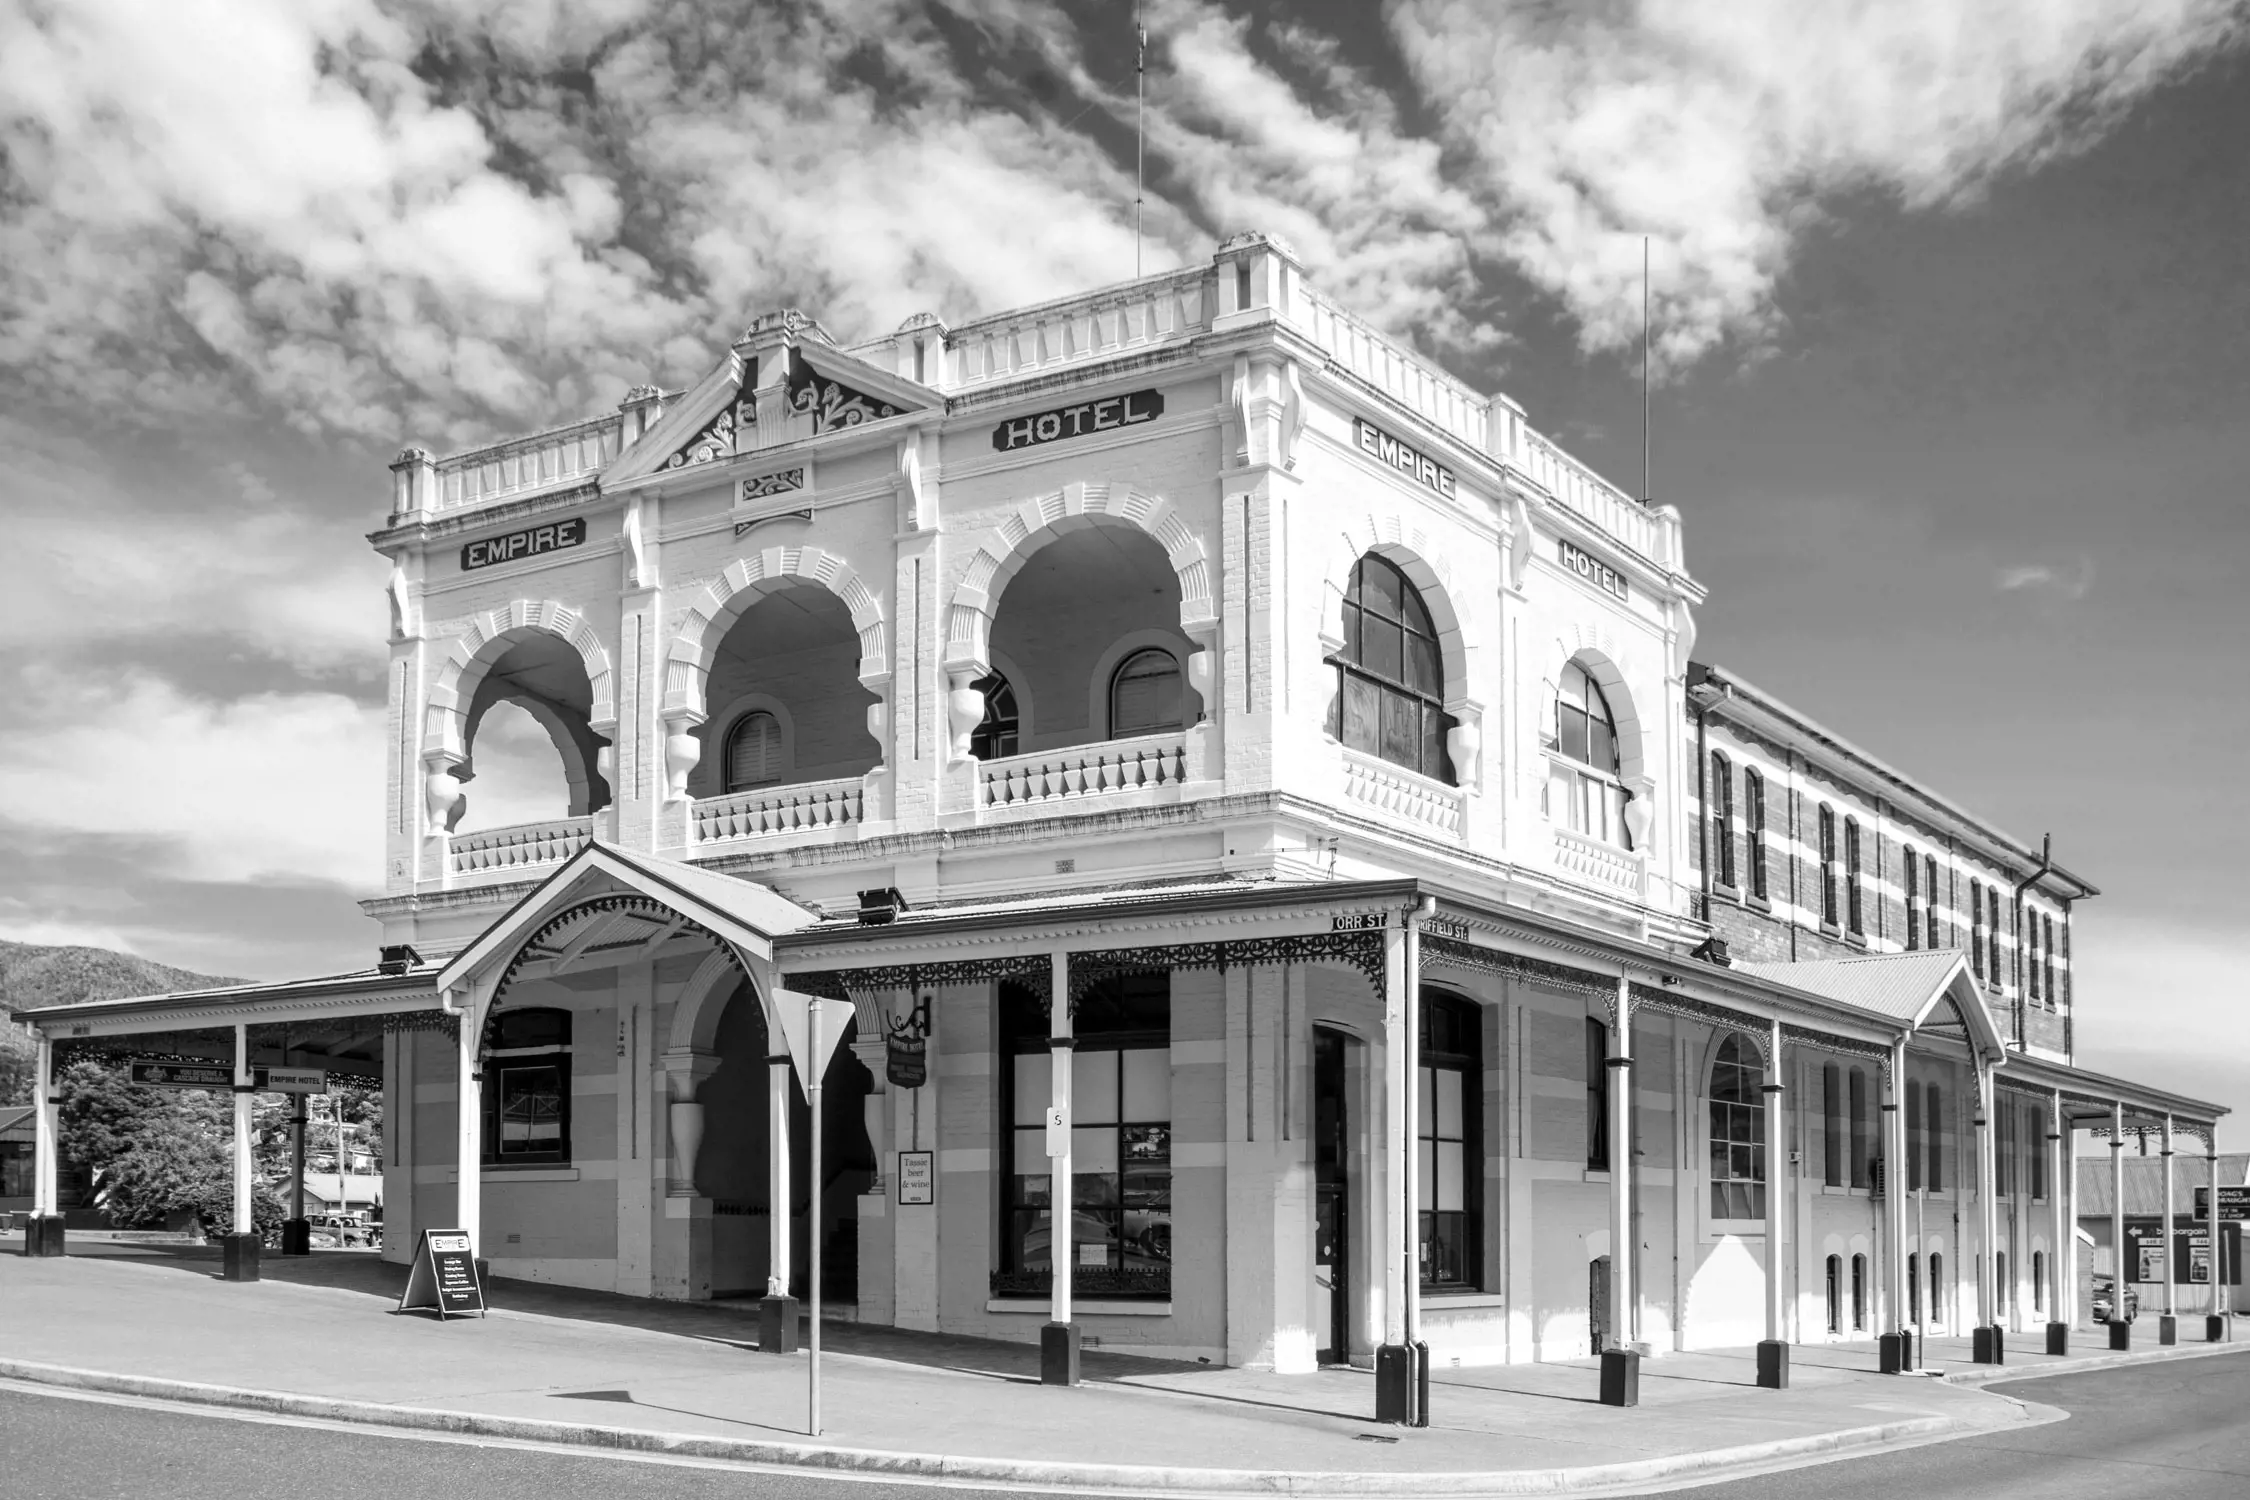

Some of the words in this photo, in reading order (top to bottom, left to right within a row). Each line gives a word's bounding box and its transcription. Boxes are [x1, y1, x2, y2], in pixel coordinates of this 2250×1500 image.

[1006, 395, 1150, 449] HOTEL
[1360, 420, 1455, 501] EMPIRE
[468, 520, 577, 568] EMPIRE
[1563, 542, 1627, 602] HOTEL
[1336, 916, 1362, 930] ORR
[1417, 918, 1453, 937] RIFFIELD
[270, 1075, 297, 1084] EMPIRE
[298, 1077, 321, 1085] HOTEL
[903, 1157, 928, 1167] Tassie
[907, 1168, 924, 1177] beer
[910, 1180, 930, 1188] wine
[435, 1238, 466, 1249] EMPIRE
